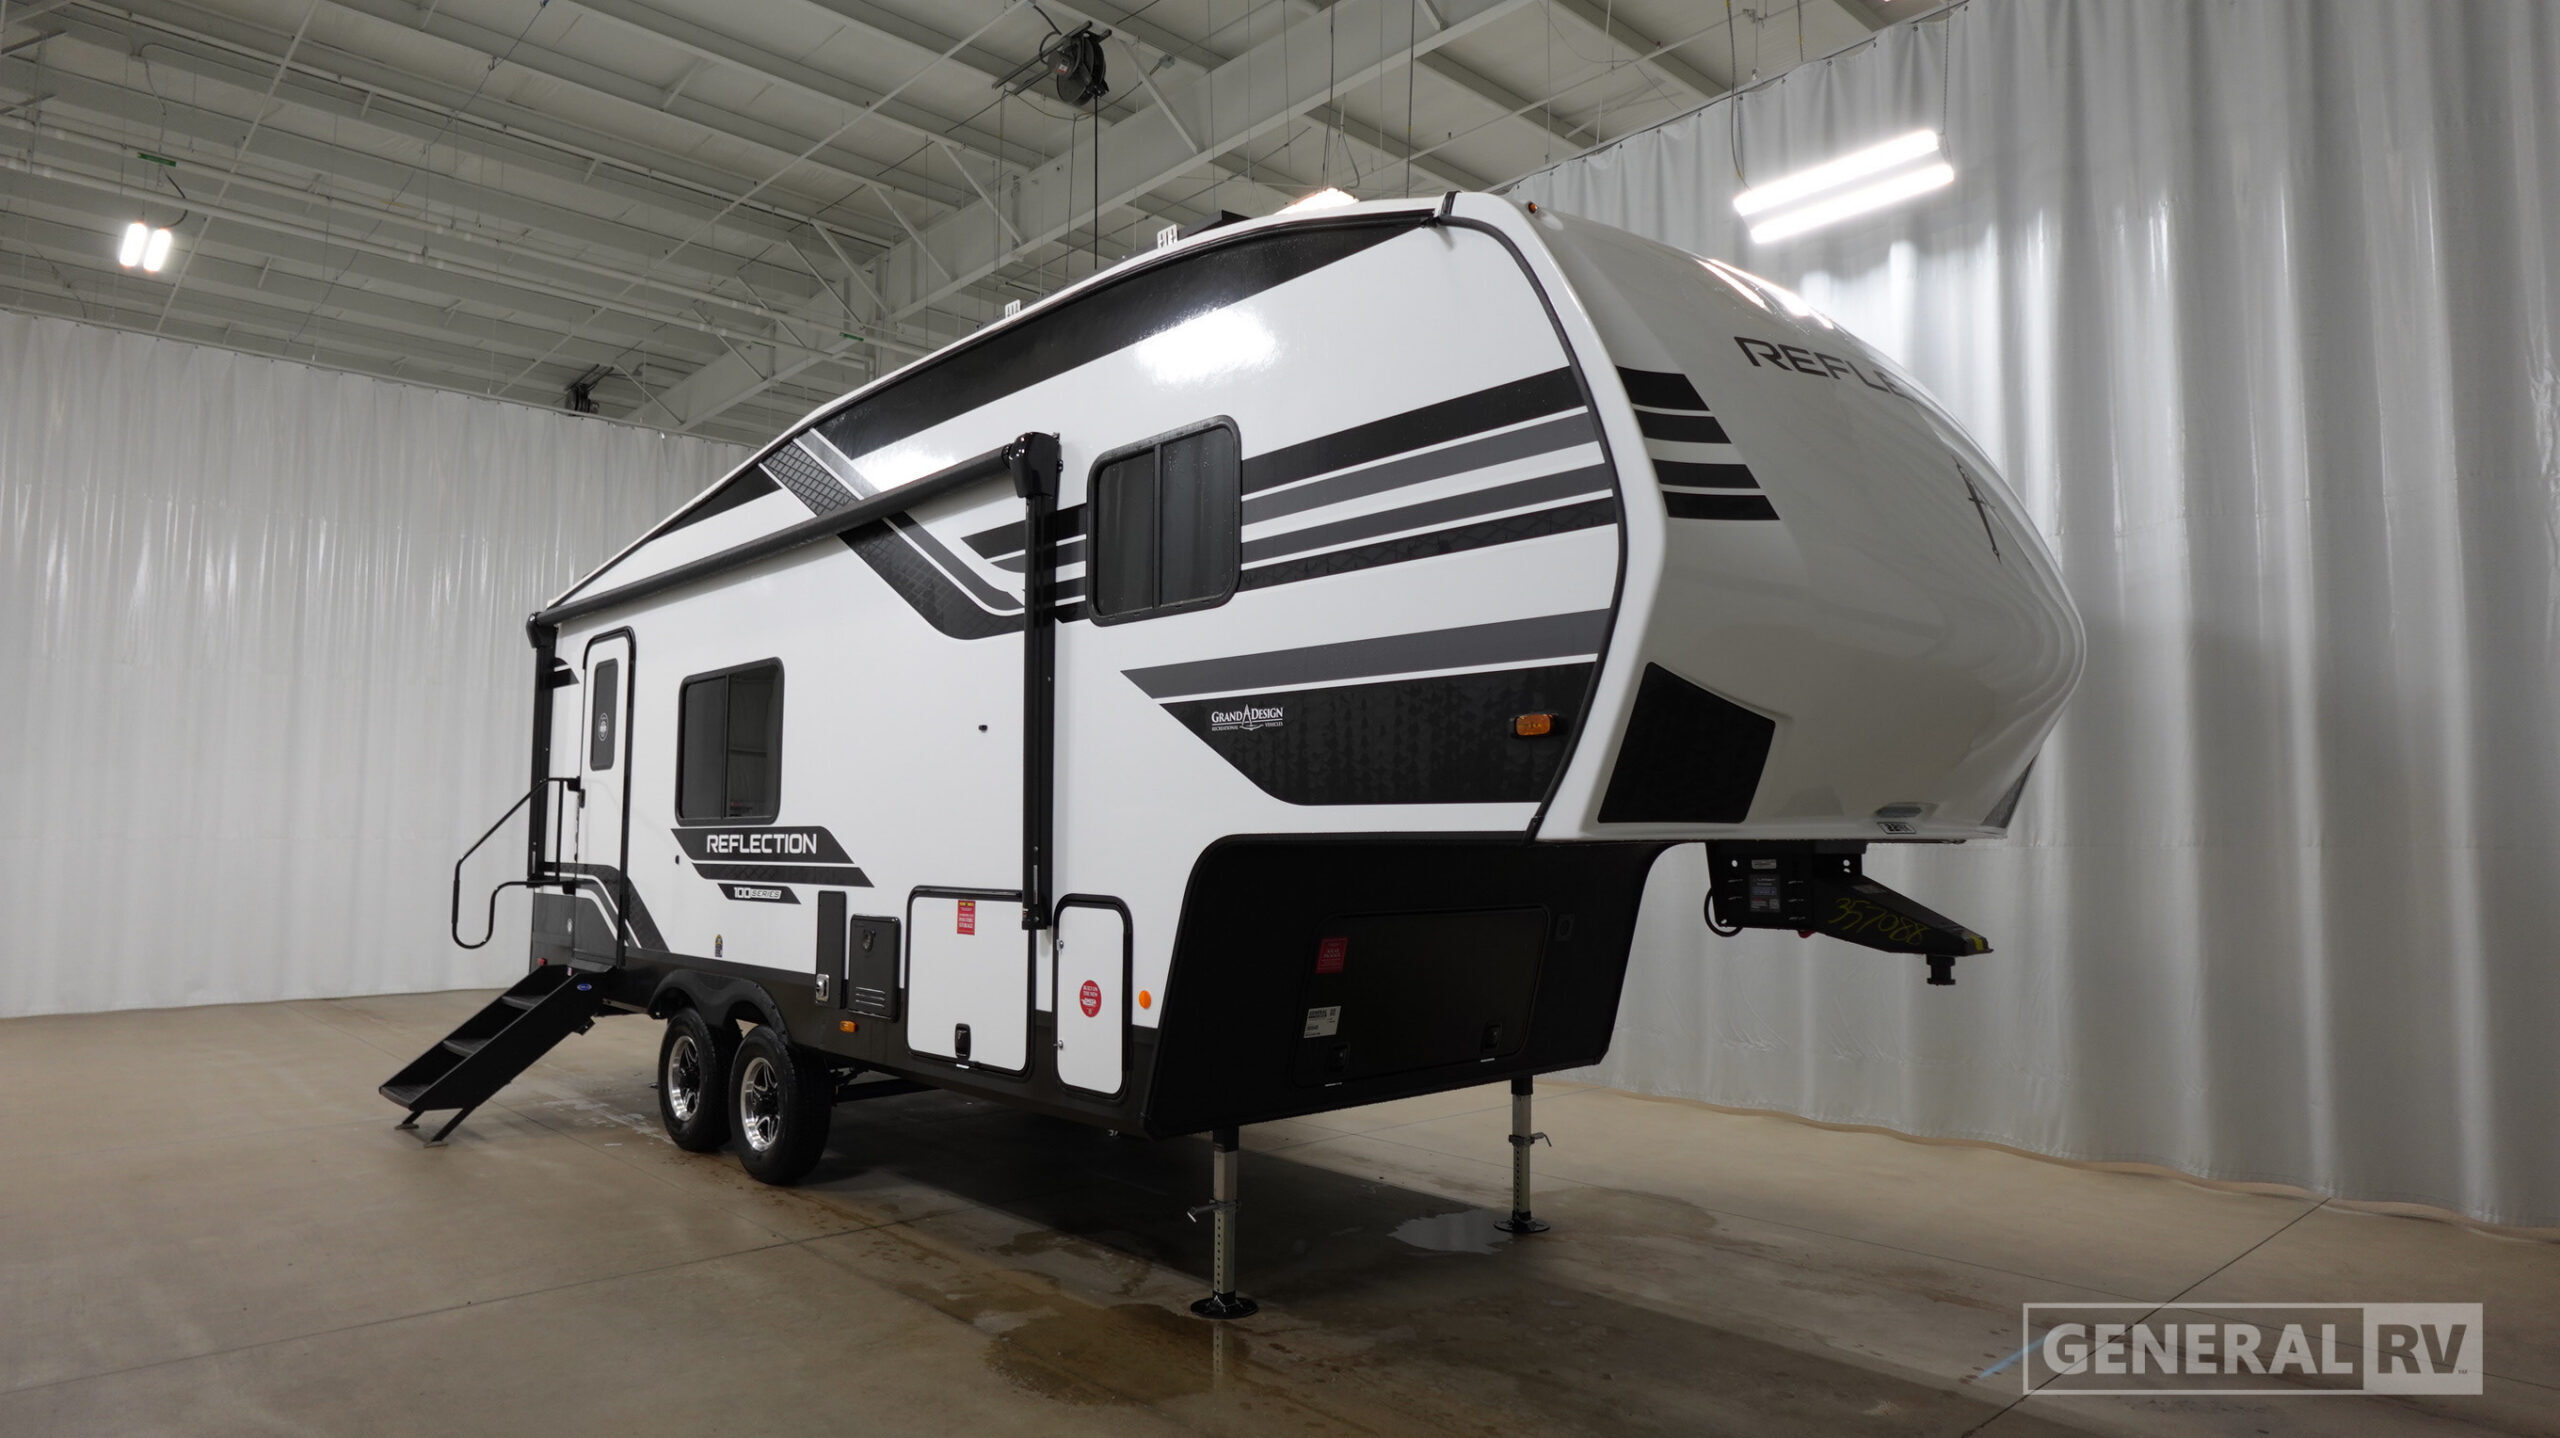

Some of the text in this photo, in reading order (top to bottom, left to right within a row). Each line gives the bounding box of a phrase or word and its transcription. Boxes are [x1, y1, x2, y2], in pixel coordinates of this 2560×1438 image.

[1211, 706, 1284, 723] GRAND DESIGN
[706, 833, 817, 855] REFLECTION
[734, 886, 782, 899] 100 SERIES
